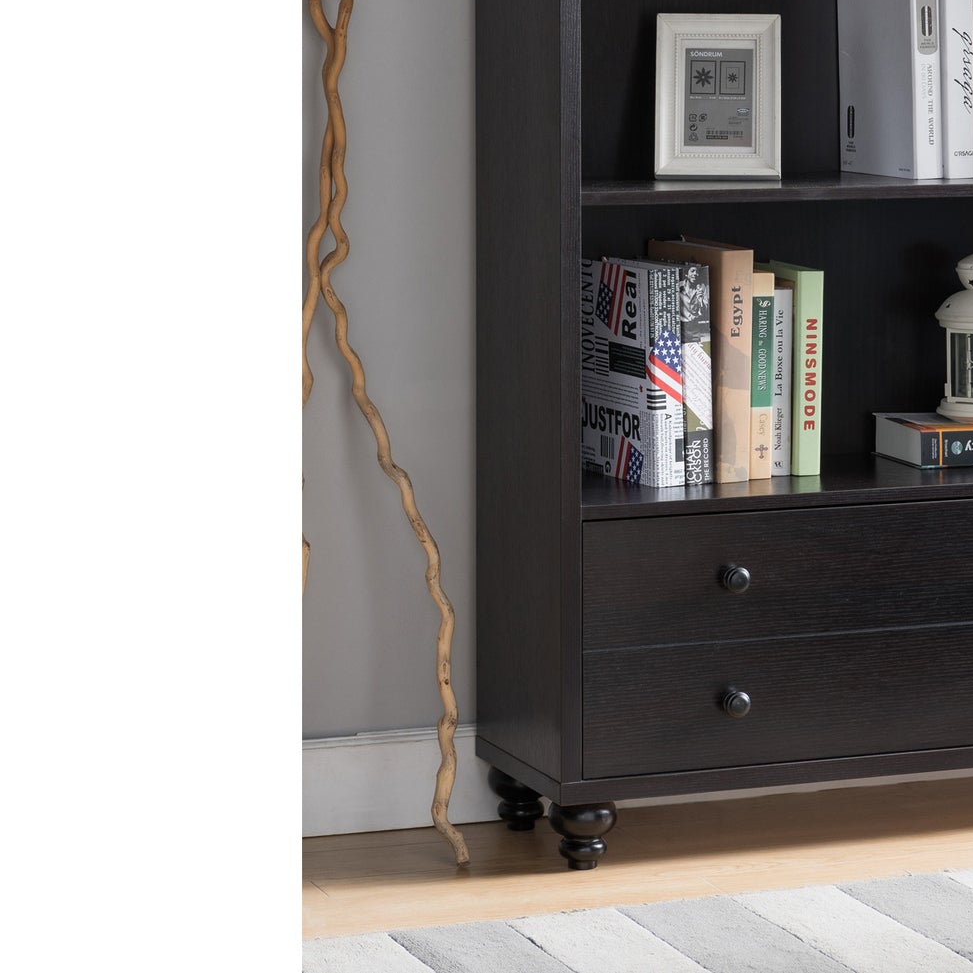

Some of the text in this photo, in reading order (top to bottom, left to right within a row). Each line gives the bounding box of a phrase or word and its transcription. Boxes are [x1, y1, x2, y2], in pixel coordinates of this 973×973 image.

[622, 269, 637, 341] Real
[730, 286, 743, 338] Egypt
[758, 348, 767, 369] GOOD
[775, 309, 784, 396] La Boxe ou la Vie
[803, 318, 818, 431] NINSMODE
[757, 370, 767, 391] NEWS
[774, 407, 784, 450] Noah Klieger
[686, 444, 695, 484] ICHAEL
[693, 440, 703, 485] CKSON
